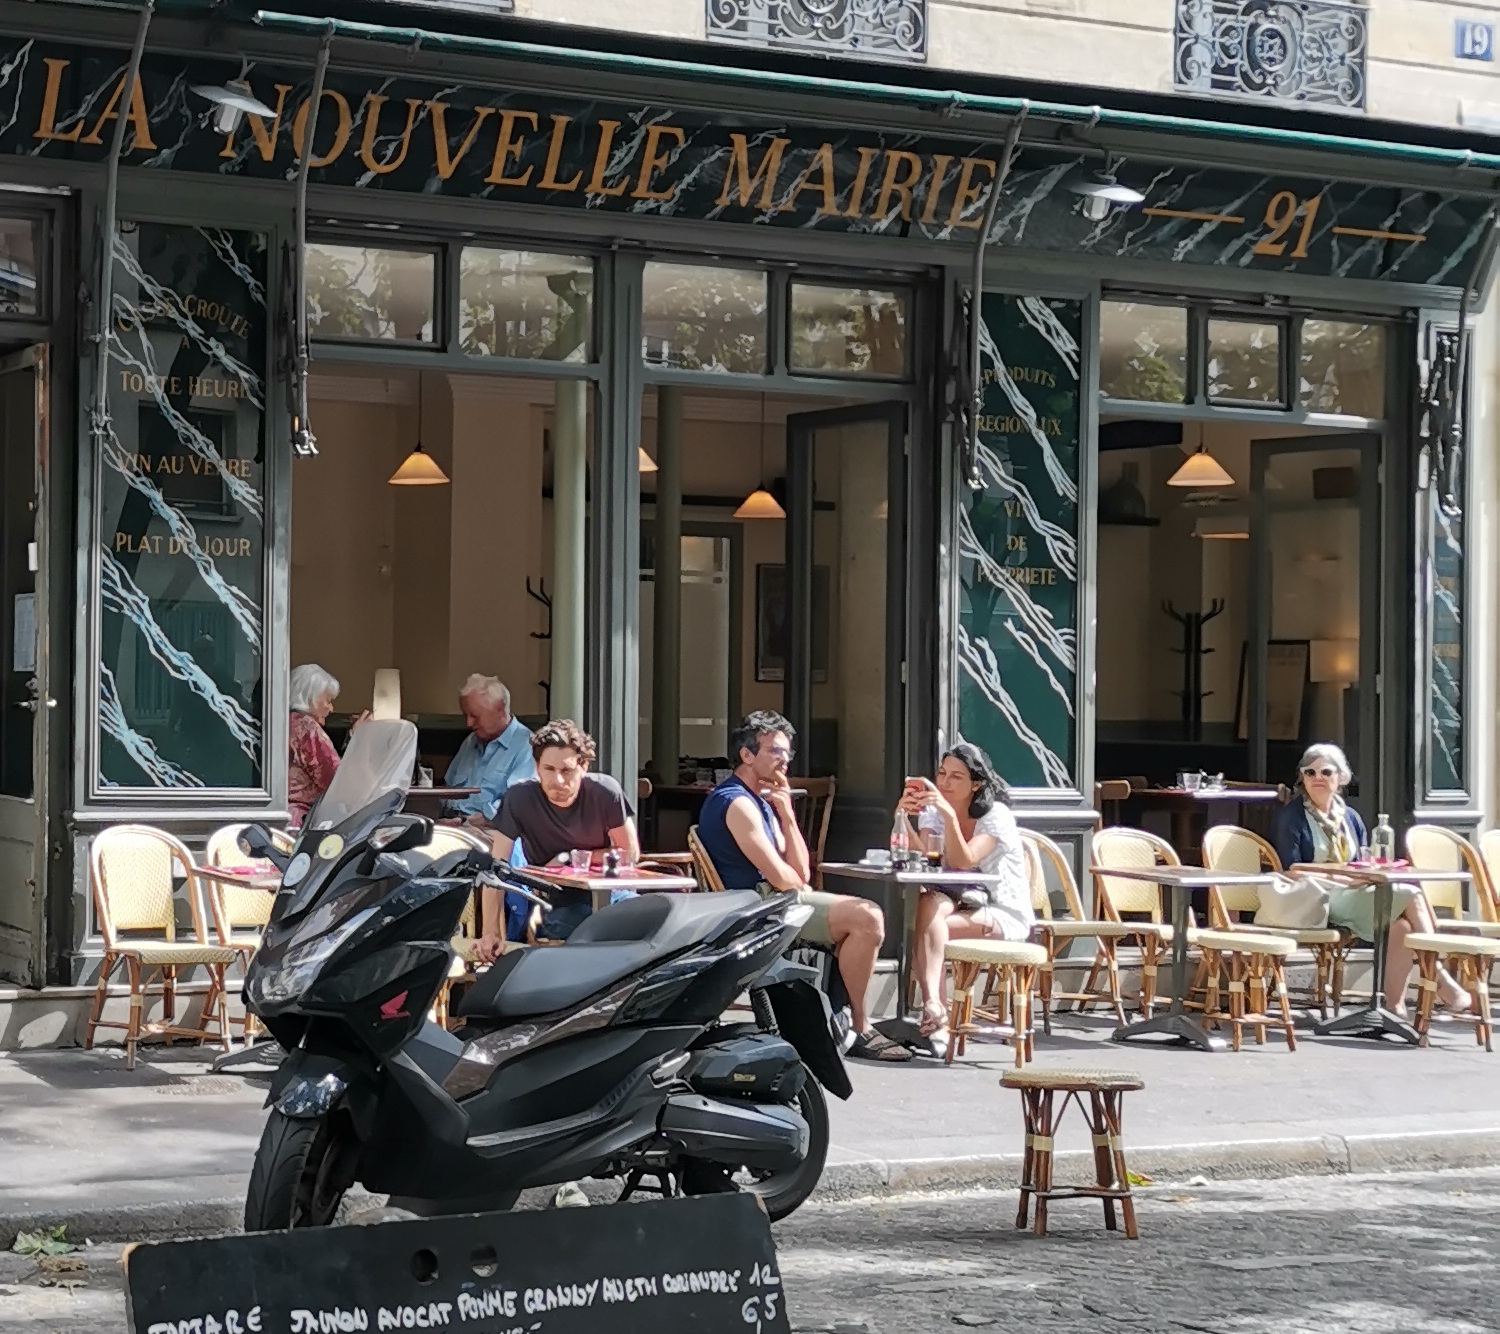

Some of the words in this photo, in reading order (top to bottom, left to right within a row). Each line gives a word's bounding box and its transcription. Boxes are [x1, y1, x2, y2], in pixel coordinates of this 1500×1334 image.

[1464, 23, 1488, 56] 19
[33, 58, 157, 150] LA
[219, 81, 684, 201] NOUVELLE
[715, 132, 997, 230] MAIRIE
[1254, 189, 1321, 260] 21
[977, 414, 1062, 436] REGIONUX
[156, 455, 185, 475] AU
[116, 532, 163, 554] PLAT
[202, 536, 251, 557] JOUR
[1007, 535, 1027, 552] DE
[977, 565, 1057, 586] PPRIETE
[378, 1302, 452, 1331] AVOCAT
[523, 1279, 600, 1314] GRANNY
[749, 1262, 780, 1286] 12
